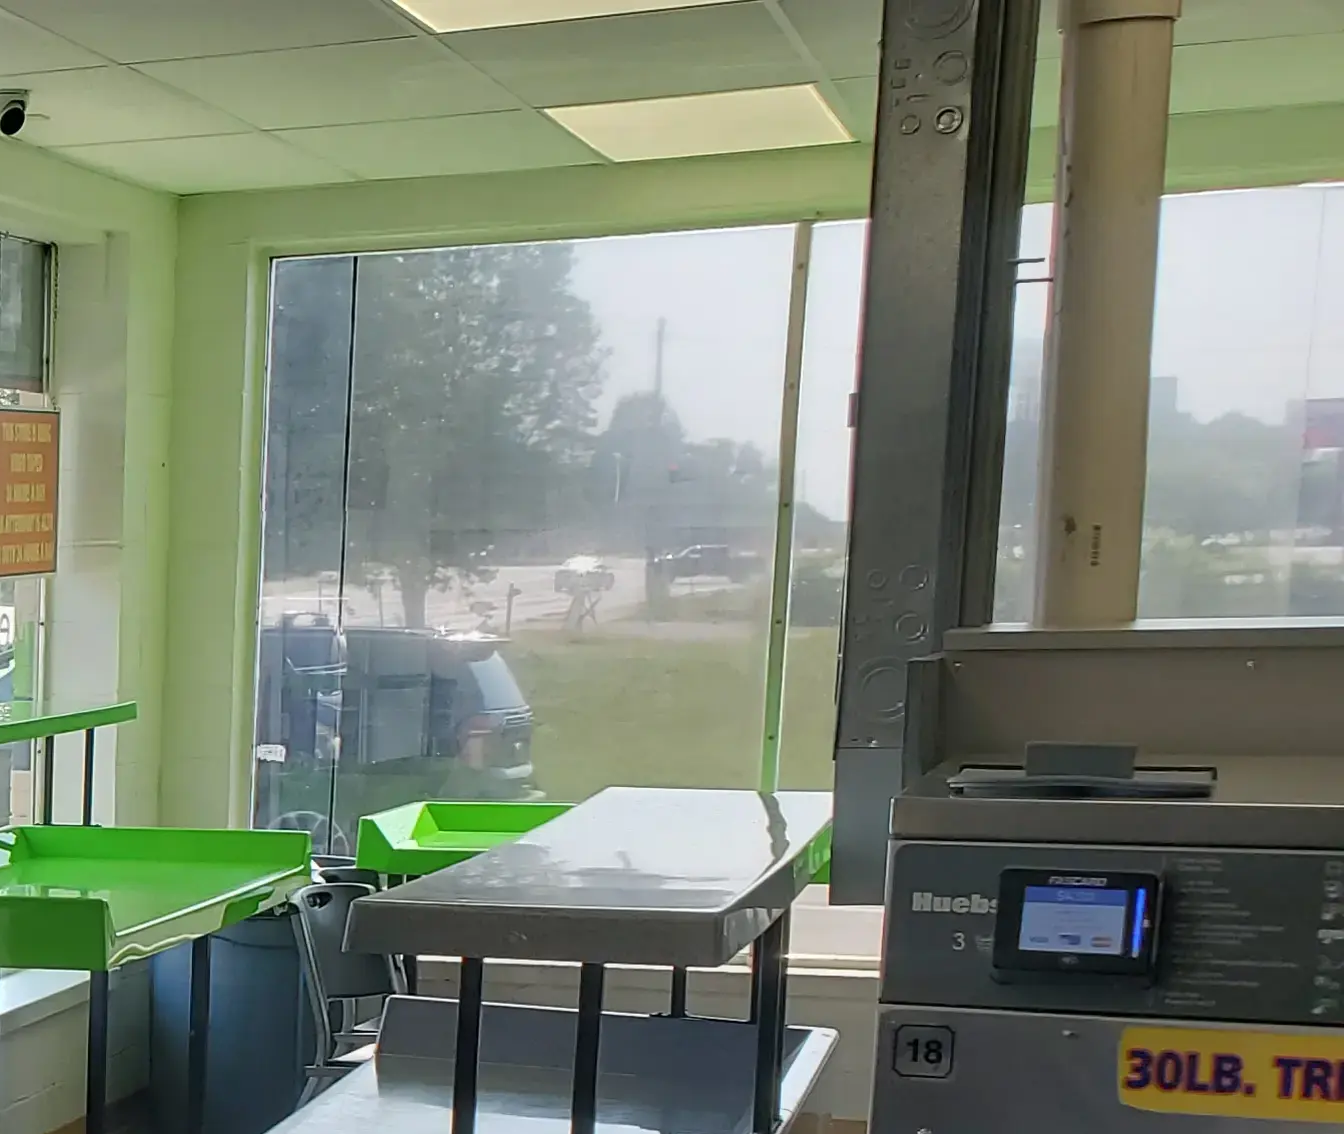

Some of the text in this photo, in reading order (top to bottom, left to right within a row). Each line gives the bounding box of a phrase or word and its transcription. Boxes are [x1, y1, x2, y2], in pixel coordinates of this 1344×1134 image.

[952, 931, 966, 950] 3
[906, 1038, 943, 1064] 18
[1124, 1047, 1256, 1096] 30LB.
